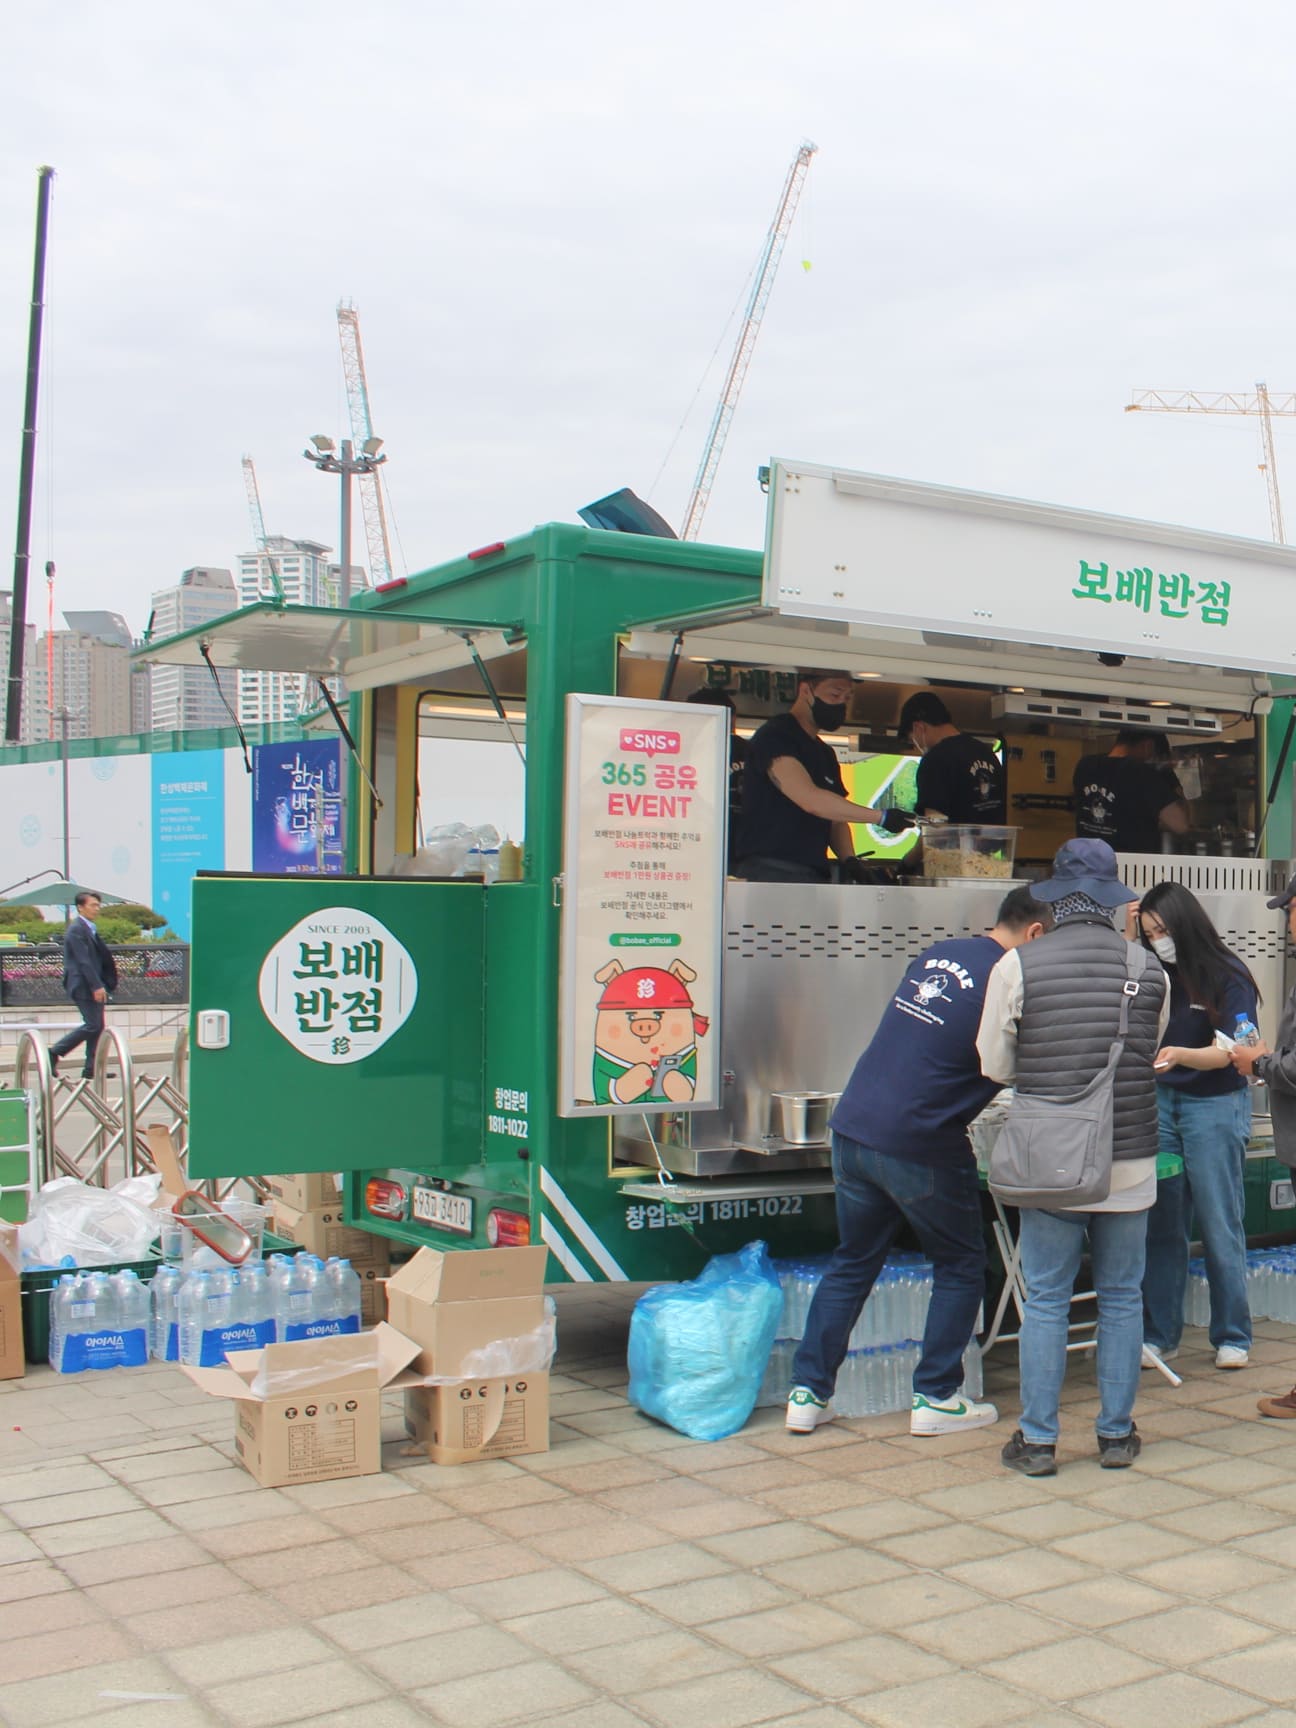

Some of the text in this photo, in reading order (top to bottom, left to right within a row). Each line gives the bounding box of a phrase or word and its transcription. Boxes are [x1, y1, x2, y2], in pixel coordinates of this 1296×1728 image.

[1071, 559, 1231, 627] 보배반점
[634, 733, 667, 750] SNS
[601, 761, 647, 787] 365
[654, 763, 698, 790] 공유
[607, 792, 693, 819] EVENT
[307, 924, 371, 936] SINCE 2003
[292, 938, 384, 984] 보배
[924, 958, 974, 990] BOBAE
[294, 986, 384, 1034] 반점
[495, 1086, 528, 1114] 창업문의
[488, 1114, 529, 1139] 1811-1022
[439, 1196, 467, 1226] 3410
[711, 1195, 803, 1221] 1811-1022
[85, 1335, 125, 1347] 아이시스
[220, 1327, 257, 1341] 아이시스
[305, 1321, 341, 1337] 아이시스
